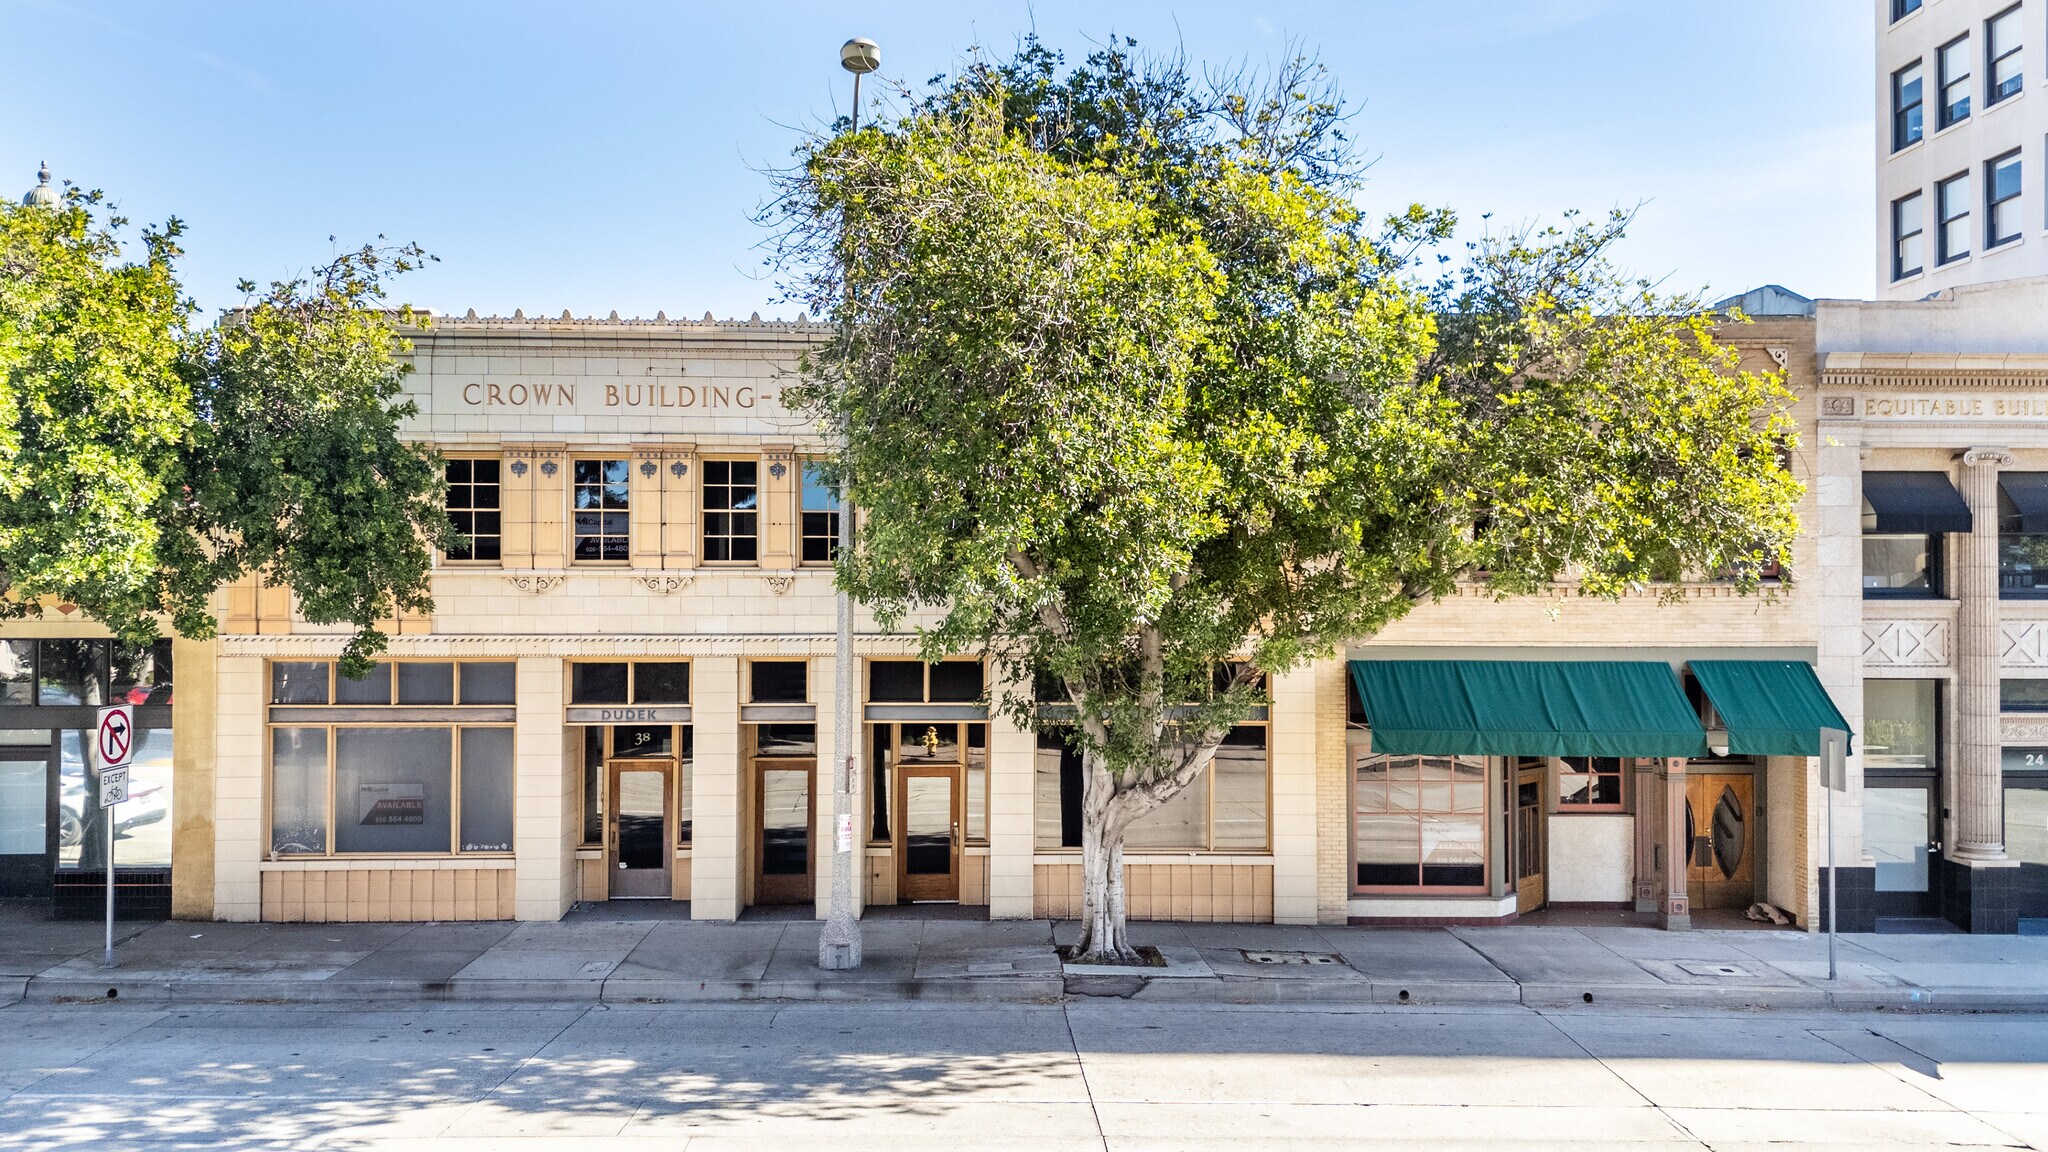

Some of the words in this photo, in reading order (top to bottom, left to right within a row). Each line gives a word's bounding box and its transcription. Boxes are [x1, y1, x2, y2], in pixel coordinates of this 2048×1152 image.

[462, 383, 575, 406] CROWN
[1865, 400, 1984, 416] EQUITABLE
[601, 710, 656, 720] DUDEK
[634, 732, 651, 746] 38
[2025, 754, 2045, 766] 24
[103, 772, 126, 785] EXCEPT
[376, 801, 422, 809] AVAILABLE
